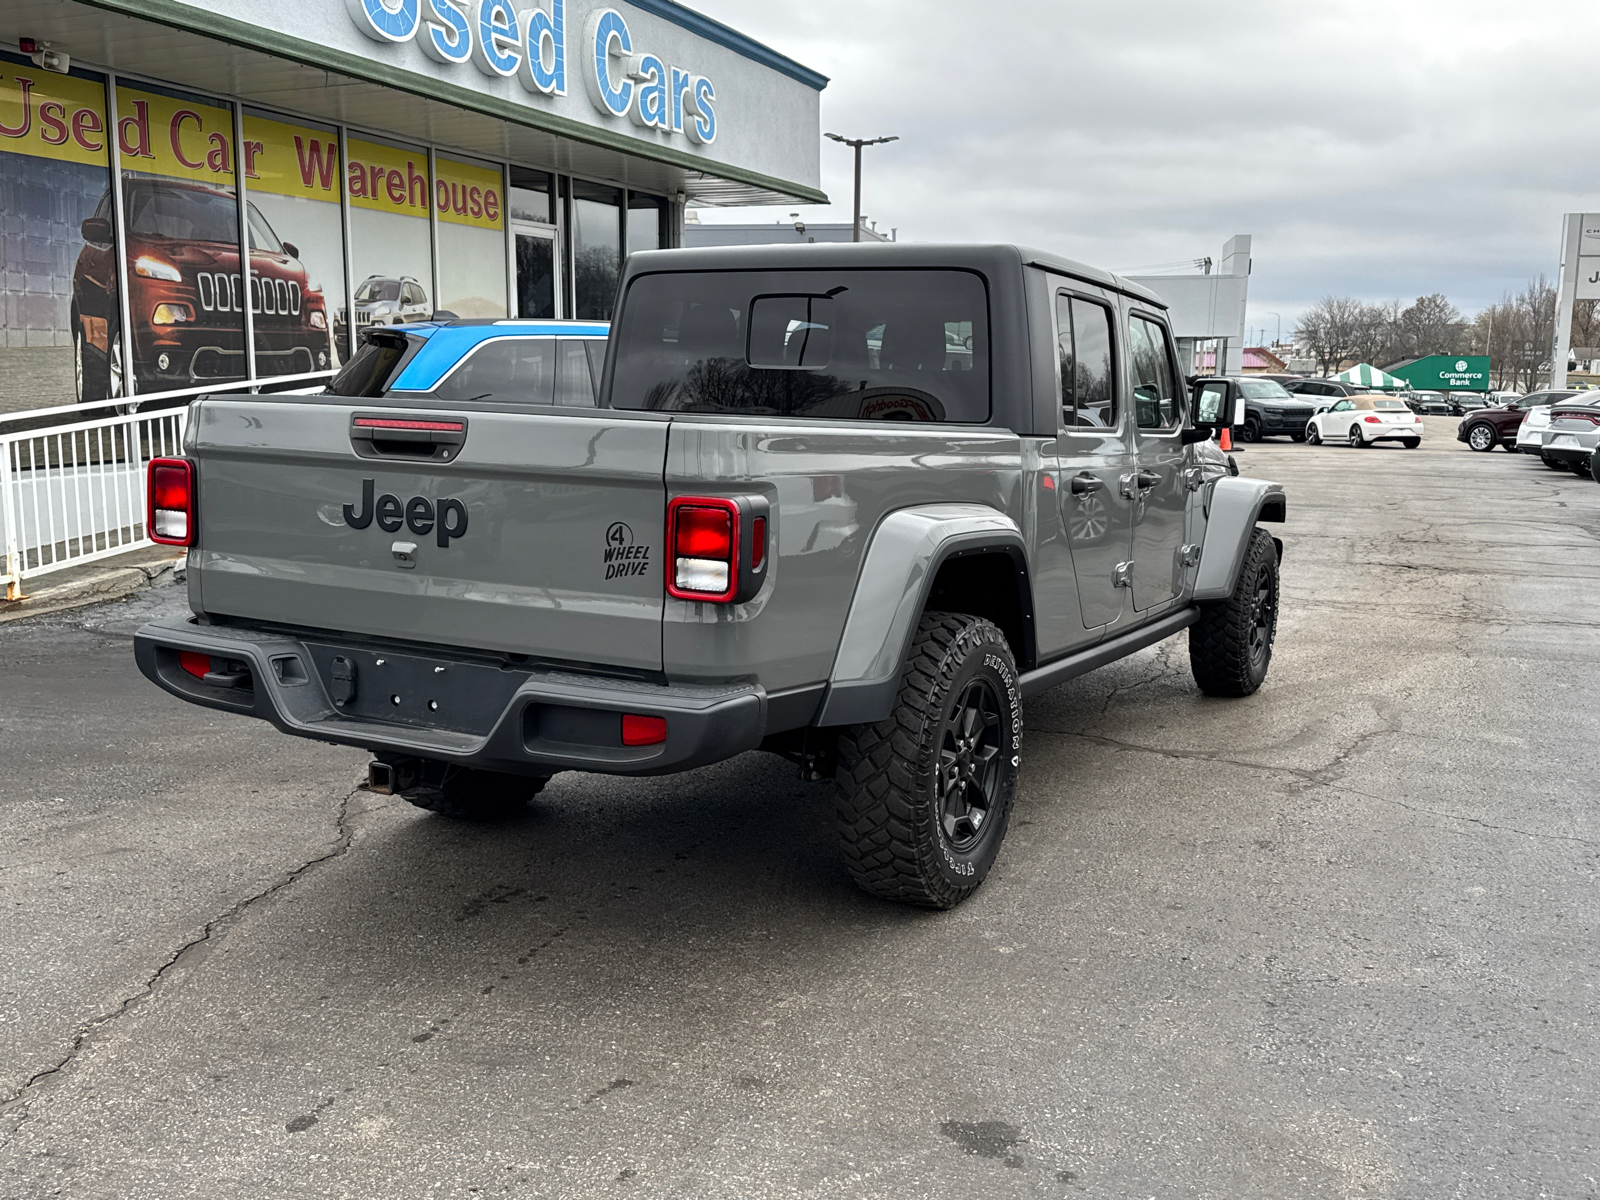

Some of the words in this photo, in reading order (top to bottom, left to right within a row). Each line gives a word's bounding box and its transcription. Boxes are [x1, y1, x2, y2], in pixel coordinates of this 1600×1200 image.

[592, 7, 717, 145] Cars
[0, 76, 155, 159] Used
[169, 109, 263, 179] Car
[293, 135, 499, 221] Warehouse
[1588, 271, 1600, 283] J
[1439, 371, 1483, 379] Commerce
[343, 477, 469, 548] Jeep
[604, 546, 650, 563] WHEEL
[604, 562, 650, 580] DRIVE
[983, 653, 1019, 749] DESTINATION
